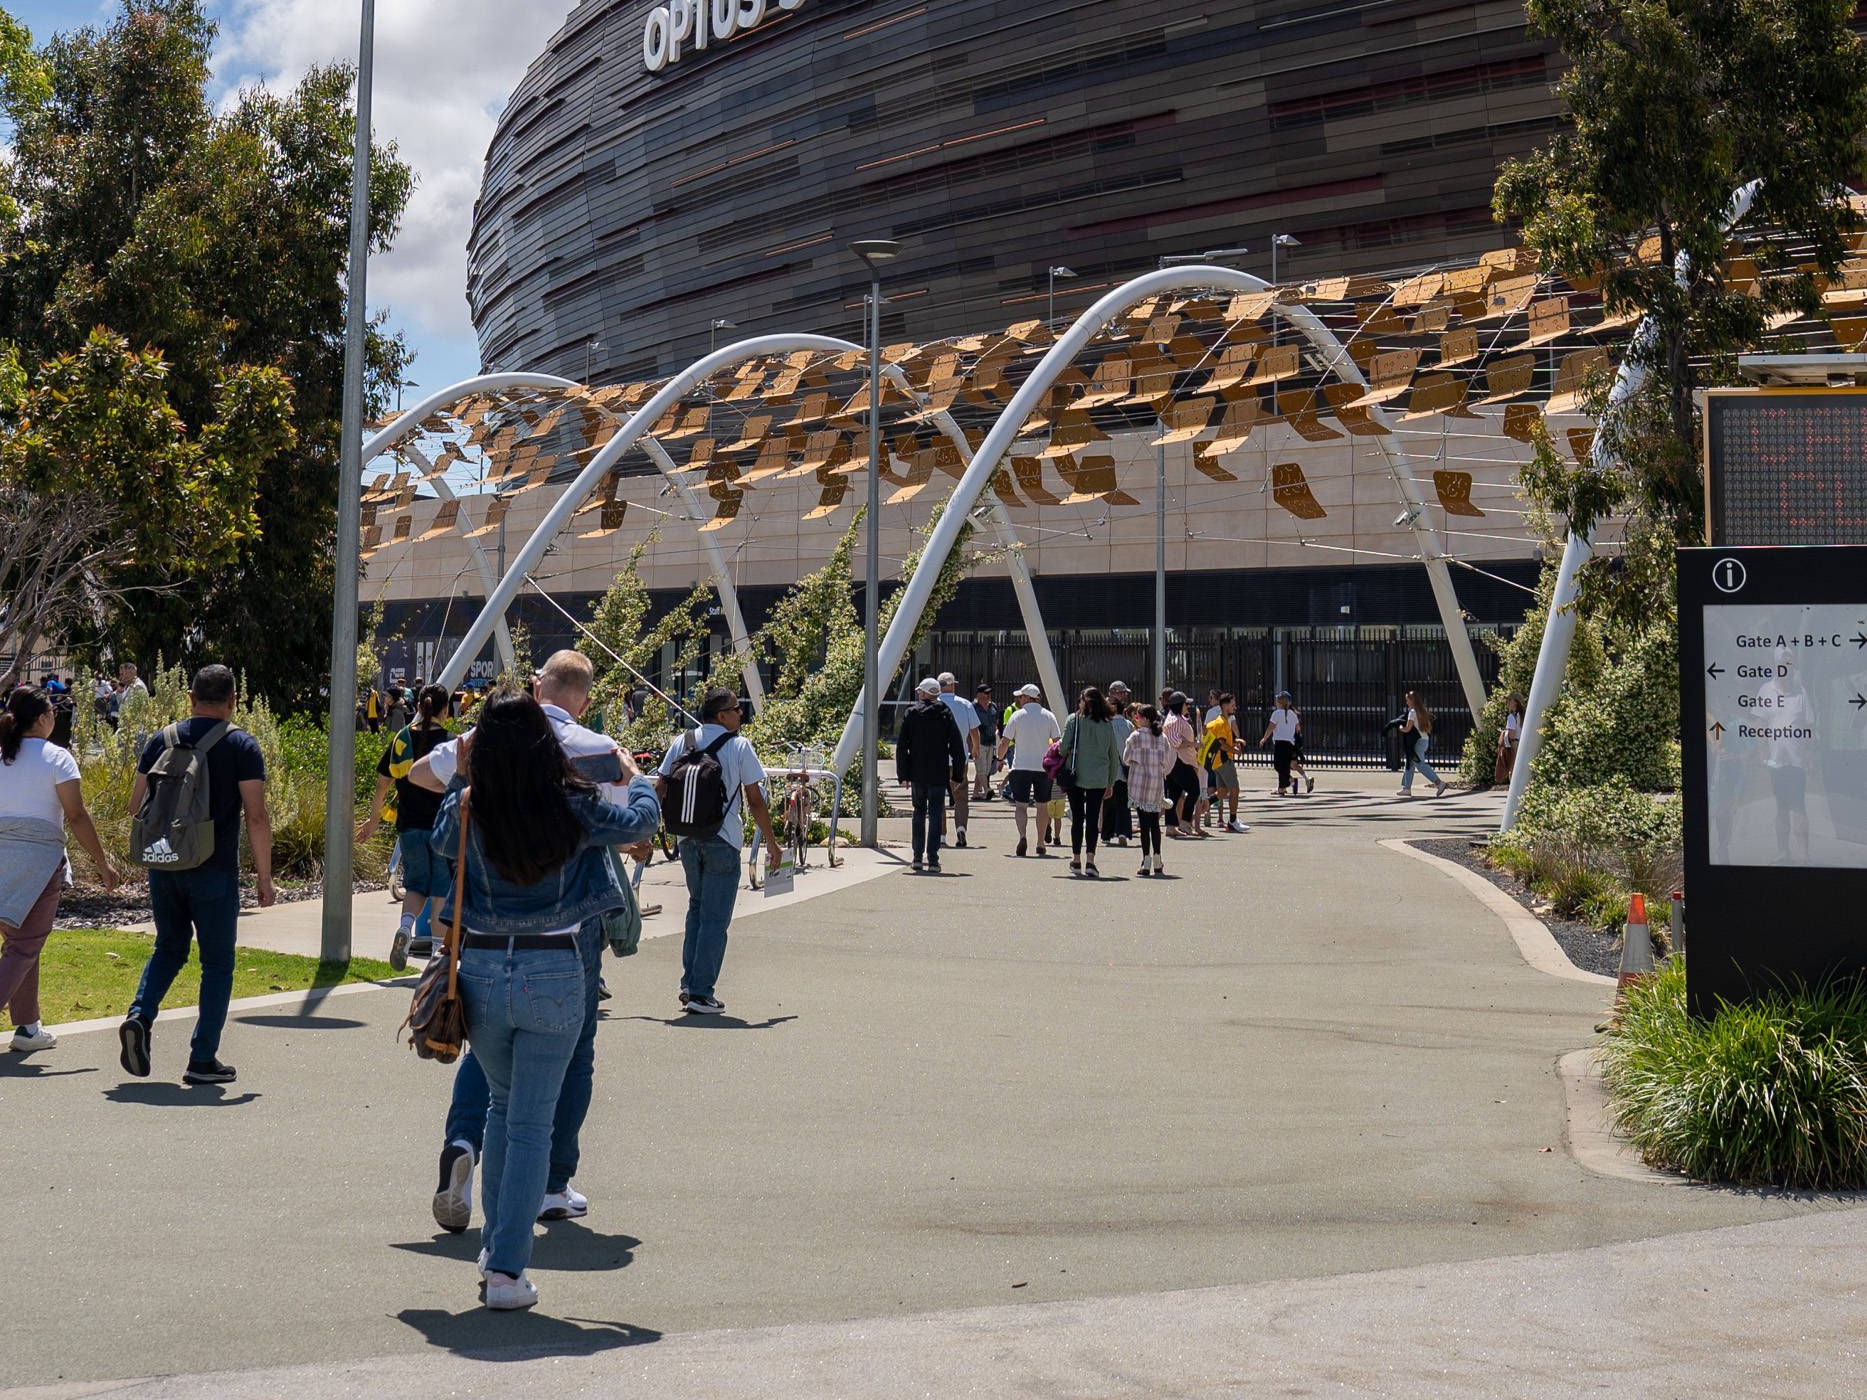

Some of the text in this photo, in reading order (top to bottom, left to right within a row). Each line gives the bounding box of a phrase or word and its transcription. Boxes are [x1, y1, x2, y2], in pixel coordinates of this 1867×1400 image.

[1736, 634, 1771, 647] Gate
[1776, 634, 1786, 647] A
[1804, 634, 1813, 647] B
[1831, 634, 1841, 647] C
[1737, 665, 1788, 678] Gate D
[1738, 695, 1785, 708] Gate E
[1738, 725, 1812, 741] Reception
